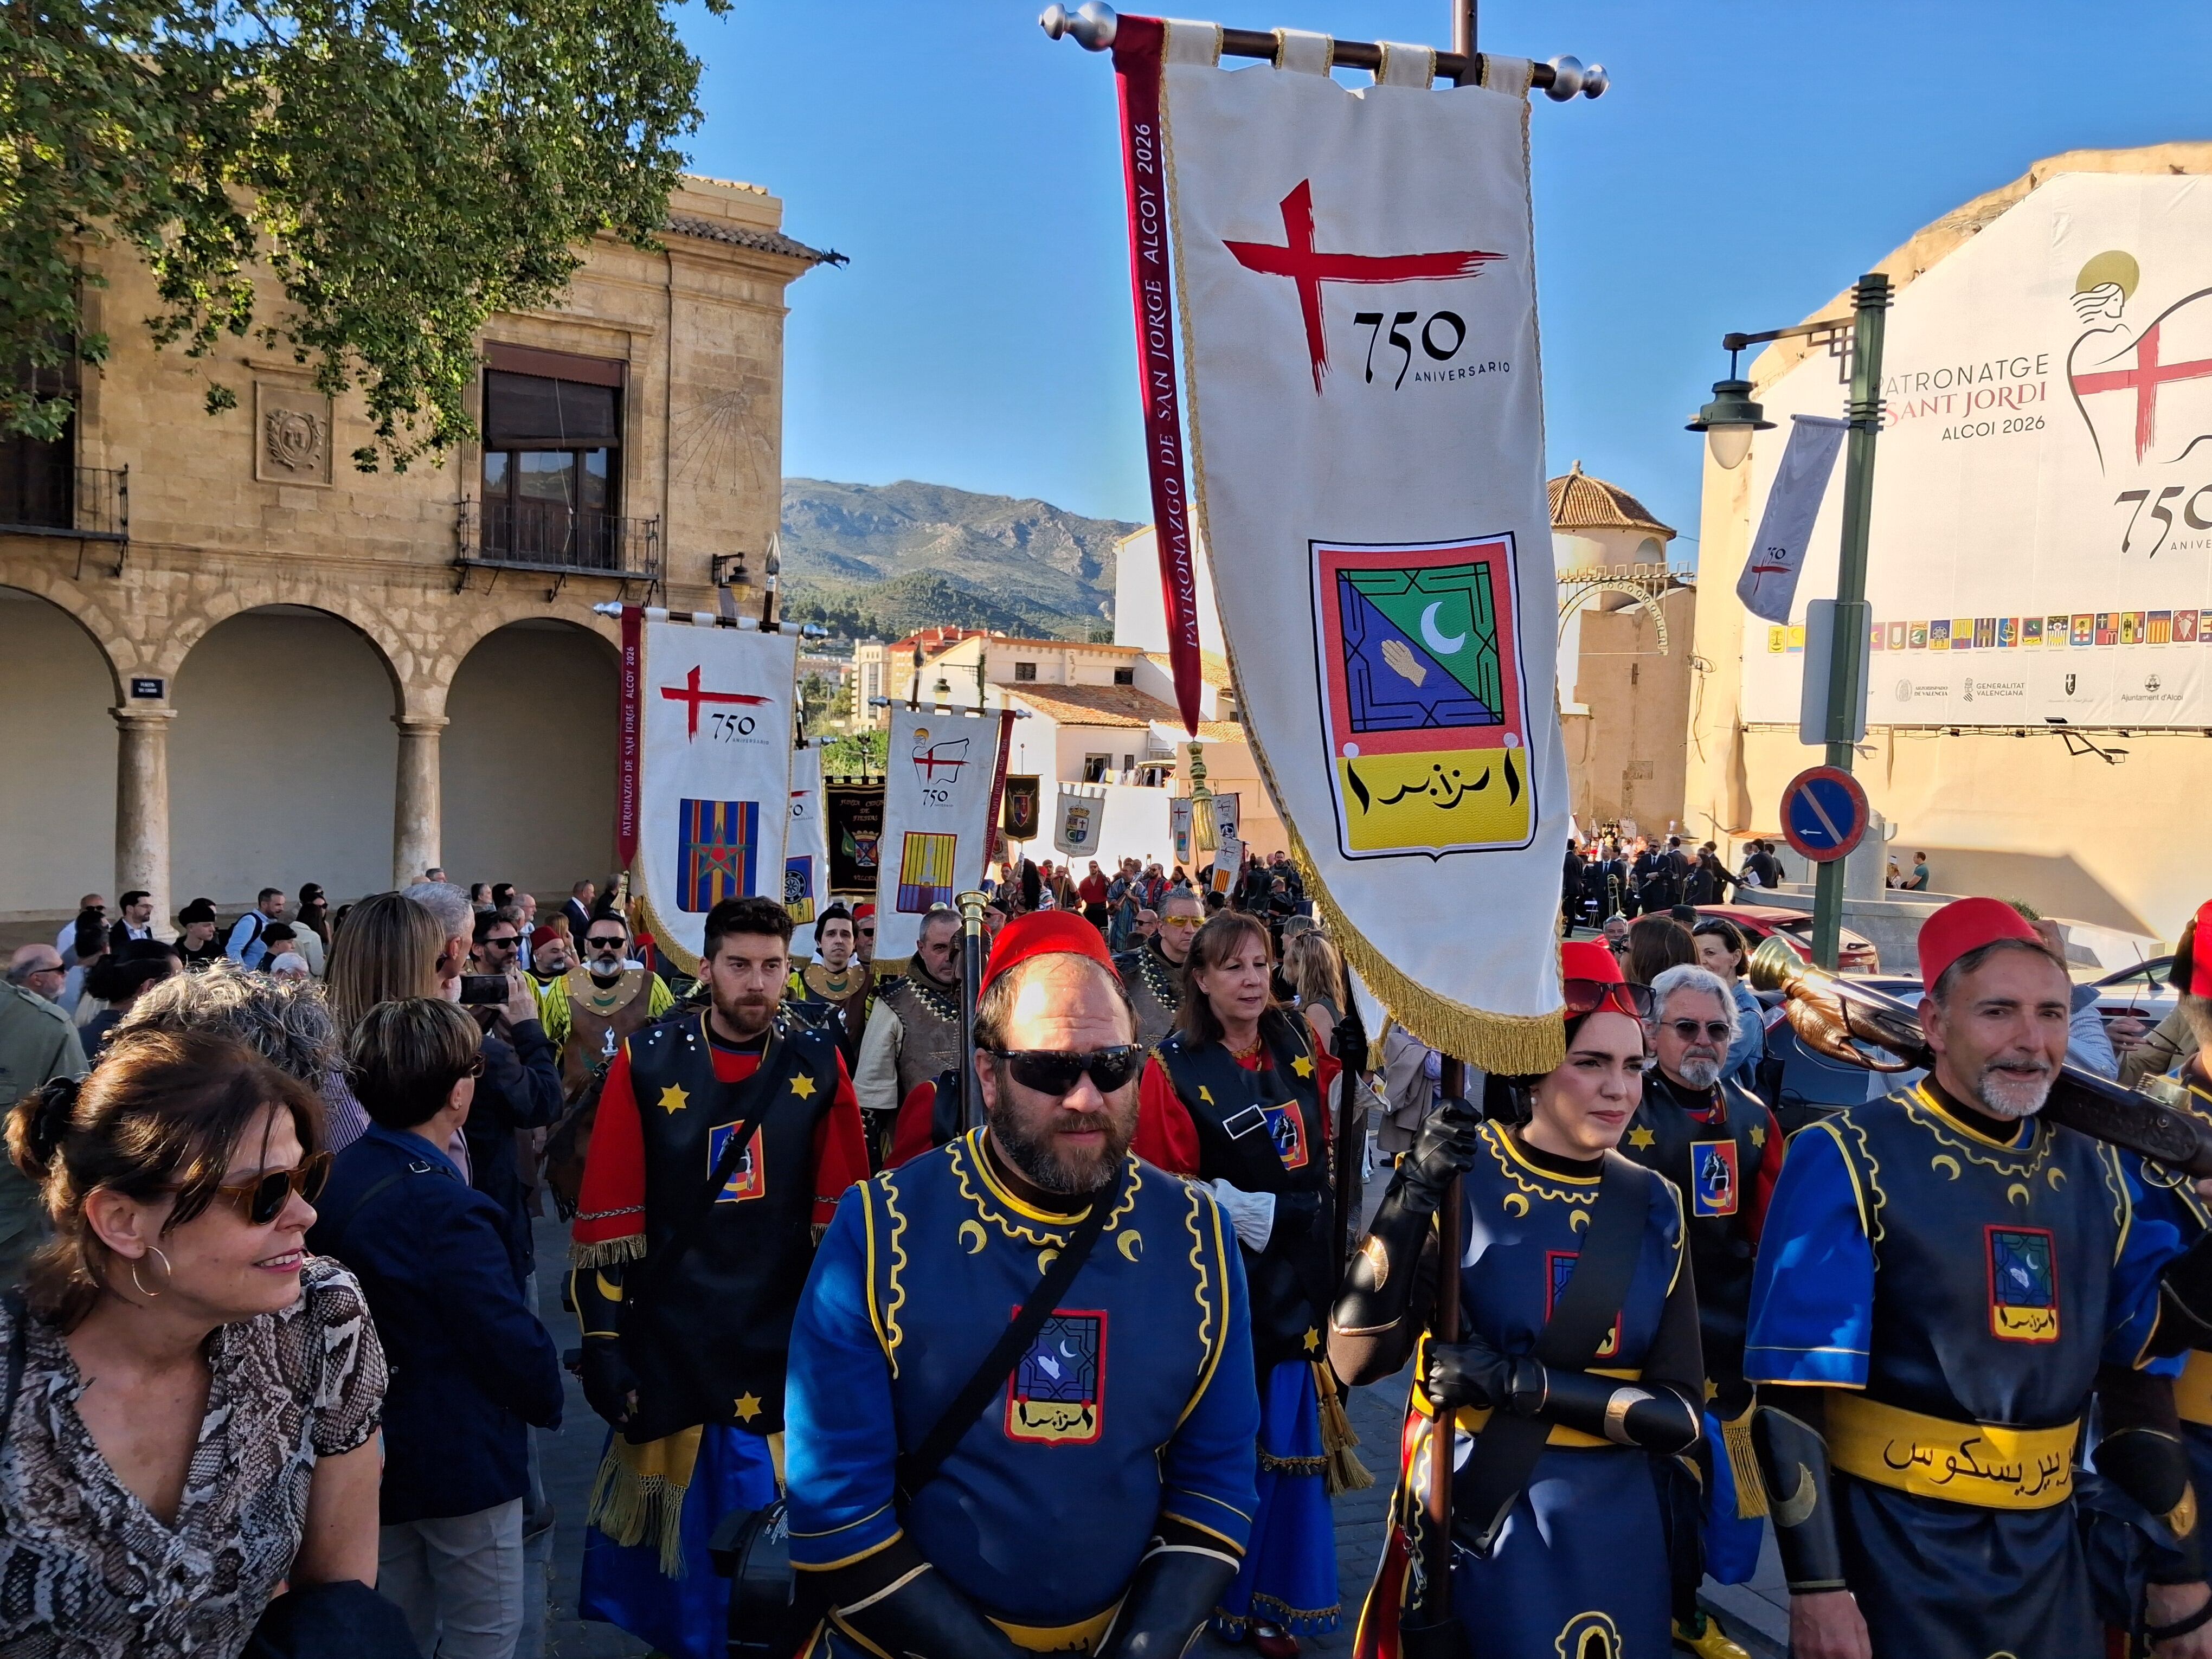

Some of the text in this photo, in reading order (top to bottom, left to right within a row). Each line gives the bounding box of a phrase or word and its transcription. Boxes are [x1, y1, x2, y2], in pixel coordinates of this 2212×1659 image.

[1354, 311, 1467, 392] 750
[1414, 361, 1510, 382] ANIVERSARIO
[1135, 124, 1198, 648] PATRONAZGO DE SAN JORGE ALCOY 2026
[1883, 381, 2046, 428] SANT JORDI
[1941, 415, 2046, 441] ALCOI 2026
[2170, 539, 2212, 551] ANIVE
[625, 670, 634, 699] ALCOY
[2121, 694, 2159, 703] Ajuntament
[625, 704, 635, 733] JORGE
[711, 713, 756, 743] 750
[625, 737, 635, 756] SAN
[625, 760, 633, 771] DE
[923, 789, 948, 807] 750
